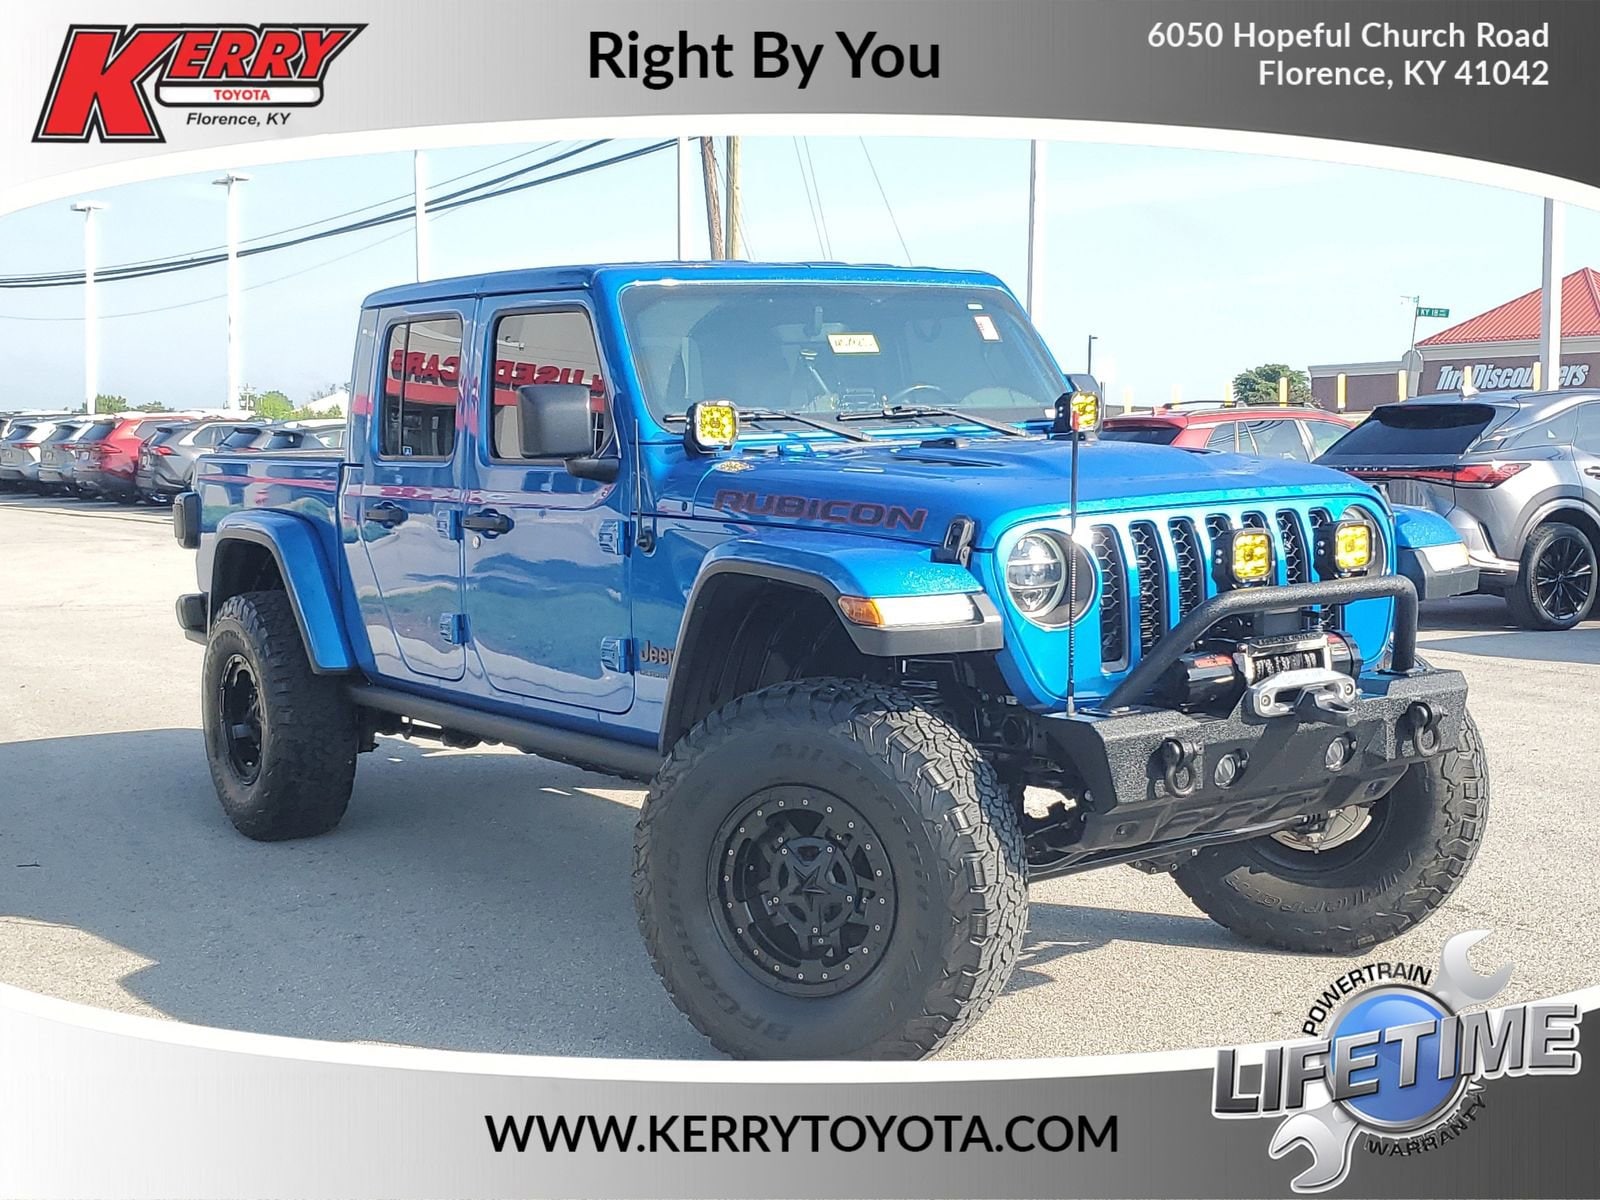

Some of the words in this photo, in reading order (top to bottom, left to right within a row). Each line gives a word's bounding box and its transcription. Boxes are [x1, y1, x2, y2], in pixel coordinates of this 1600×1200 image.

[1436, 366, 1466, 391] Tir
[1471, 363, 1590, 390] Discouers
[712, 488, 929, 532] RUBICON
